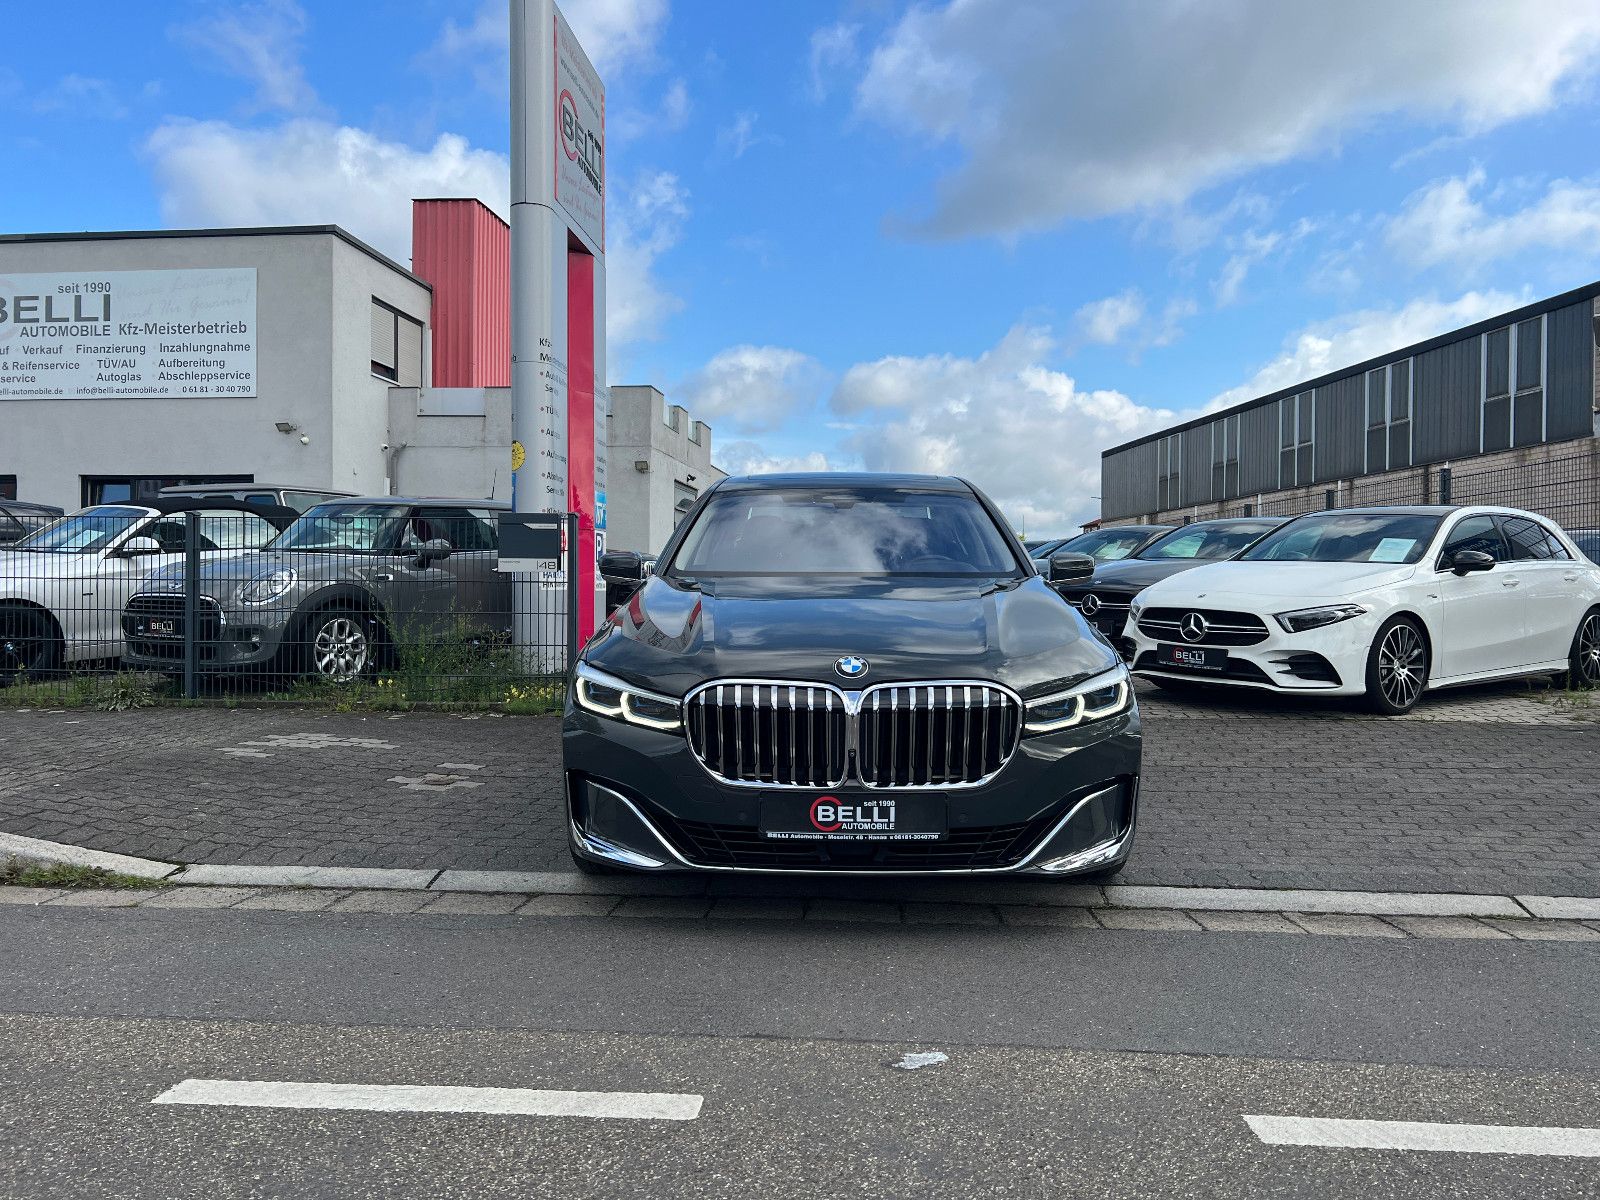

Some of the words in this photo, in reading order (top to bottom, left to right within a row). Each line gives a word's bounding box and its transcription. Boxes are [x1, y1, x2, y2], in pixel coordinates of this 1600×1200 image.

[57, 283, 80, 294] seit
[83, 282, 111, 293] 1990
[20, 325, 111, 338] AUTOMOBILE
[119, 320, 247, 336] Kfz-Meisterbetrieb
[22, 344, 63, 355] Verkauf
[76, 344, 146, 356] Finanzierung
[159, 342, 251, 355] Inzahlungnahme
[2, 361, 9, 370] &
[12, 361, 80, 371] Reifenservice
[97, 358, 136, 369] TÜV/AU
[158, 358, 226, 370] Aufbereitung
[96, 372, 142, 384] Autoglas
[158, 370, 251, 382] Abschleppservice
[76, 386, 169, 396] info@belli-automobile.de
[538, 561, 557, 570] 48
[1175, 650, 1205, 662] BELLI
[817, 805, 896, 822] BELLI
[841, 822, 895, 830] AUTOMOBILE
